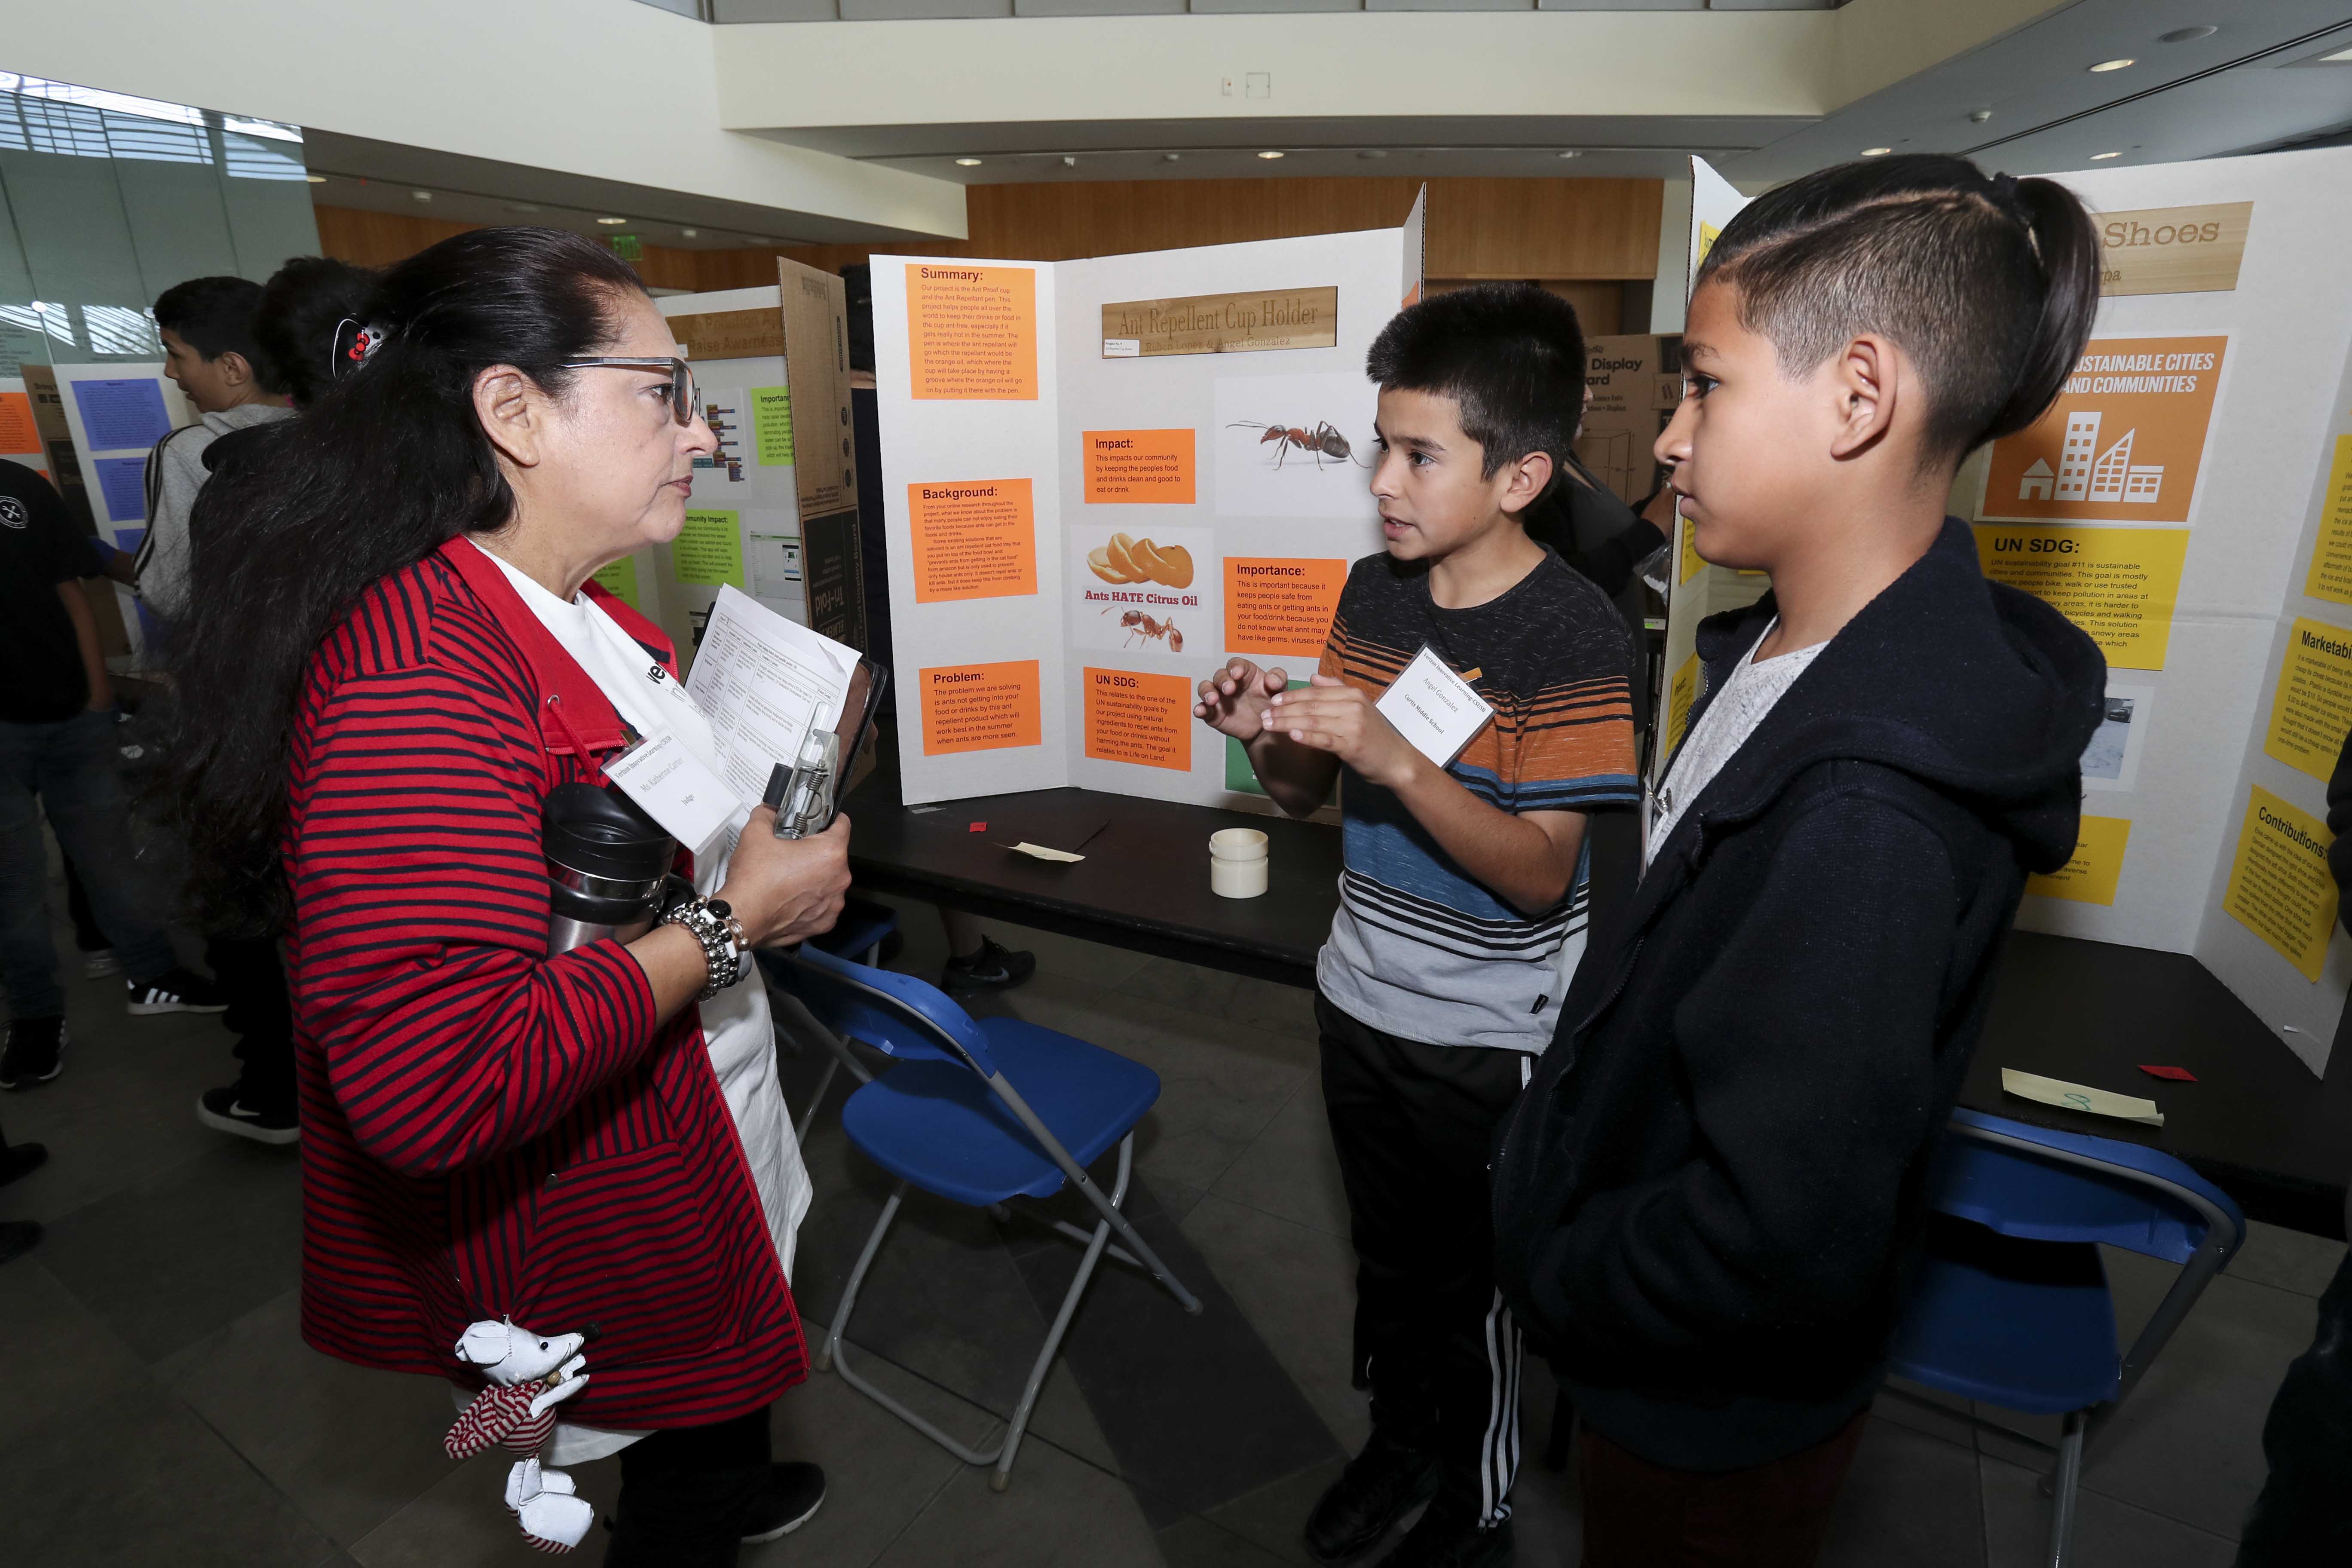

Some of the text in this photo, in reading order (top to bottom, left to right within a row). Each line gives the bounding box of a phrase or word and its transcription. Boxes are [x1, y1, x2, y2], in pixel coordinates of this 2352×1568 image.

[2102, 221, 2220, 248] Shoes
[921, 268, 983, 283] Summary:
[705, 315, 759, 329] Pollution
[1118, 299, 1319, 339] Ant Repellent Cup Holder
[689, 338, 719, 352] Raise
[1145, 342, 1173, 352] Ruben
[1176, 341, 1204, 351] Lopez
[1218, 337, 1244, 349] Angel
[1247, 336, 1291, 347] Gonzalez
[1592, 358, 1643, 373] Display
[2073, 353, 2214, 372] USTAINABLE CITIES
[1586, 374, 1610, 386] ard
[2061, 375, 2197, 394] AND COMMUNITIES
[1096, 438, 1133, 451] Impact:
[1145, 454, 1178, 462] community
[1139, 465, 1163, 473] peoples
[1158, 475, 1173, 484] good
[923, 486, 997, 500] Background:
[708, 516, 728, 524] Impact:
[1995, 538, 2079, 553] UN SDG:
[1237, 564, 1305, 577] Importance:
[1259, 581, 1290, 589] important
[815, 586, 844, 617] Tri-Fold
[1084, 590, 1198, 606] Ants HATE Citrus Oil
[1237, 591, 1256, 600] keeps
[1258, 592, 1280, 600] people
[1237, 602, 1257, 611] eating
[1282, 604, 1305, 612] getting
[934, 672, 984, 684] Problem:
[1096, 674, 1139, 688] UN SDG:
[1424, 653, 1486, 712] Verizon Innovative Learning-CSUSB
[948, 687, 974, 696] problem
[1423, 678, 1458, 713] Angel Gonzalez
[969, 696, 990, 704] getting
[936, 717, 963, 726] repellent
[965, 715, 989, 724] product
[1404, 694, 1445, 735] Curtis Middle School
[681, 794, 694, 806] Judge
[2259, 806, 2328, 860] Contributions:
